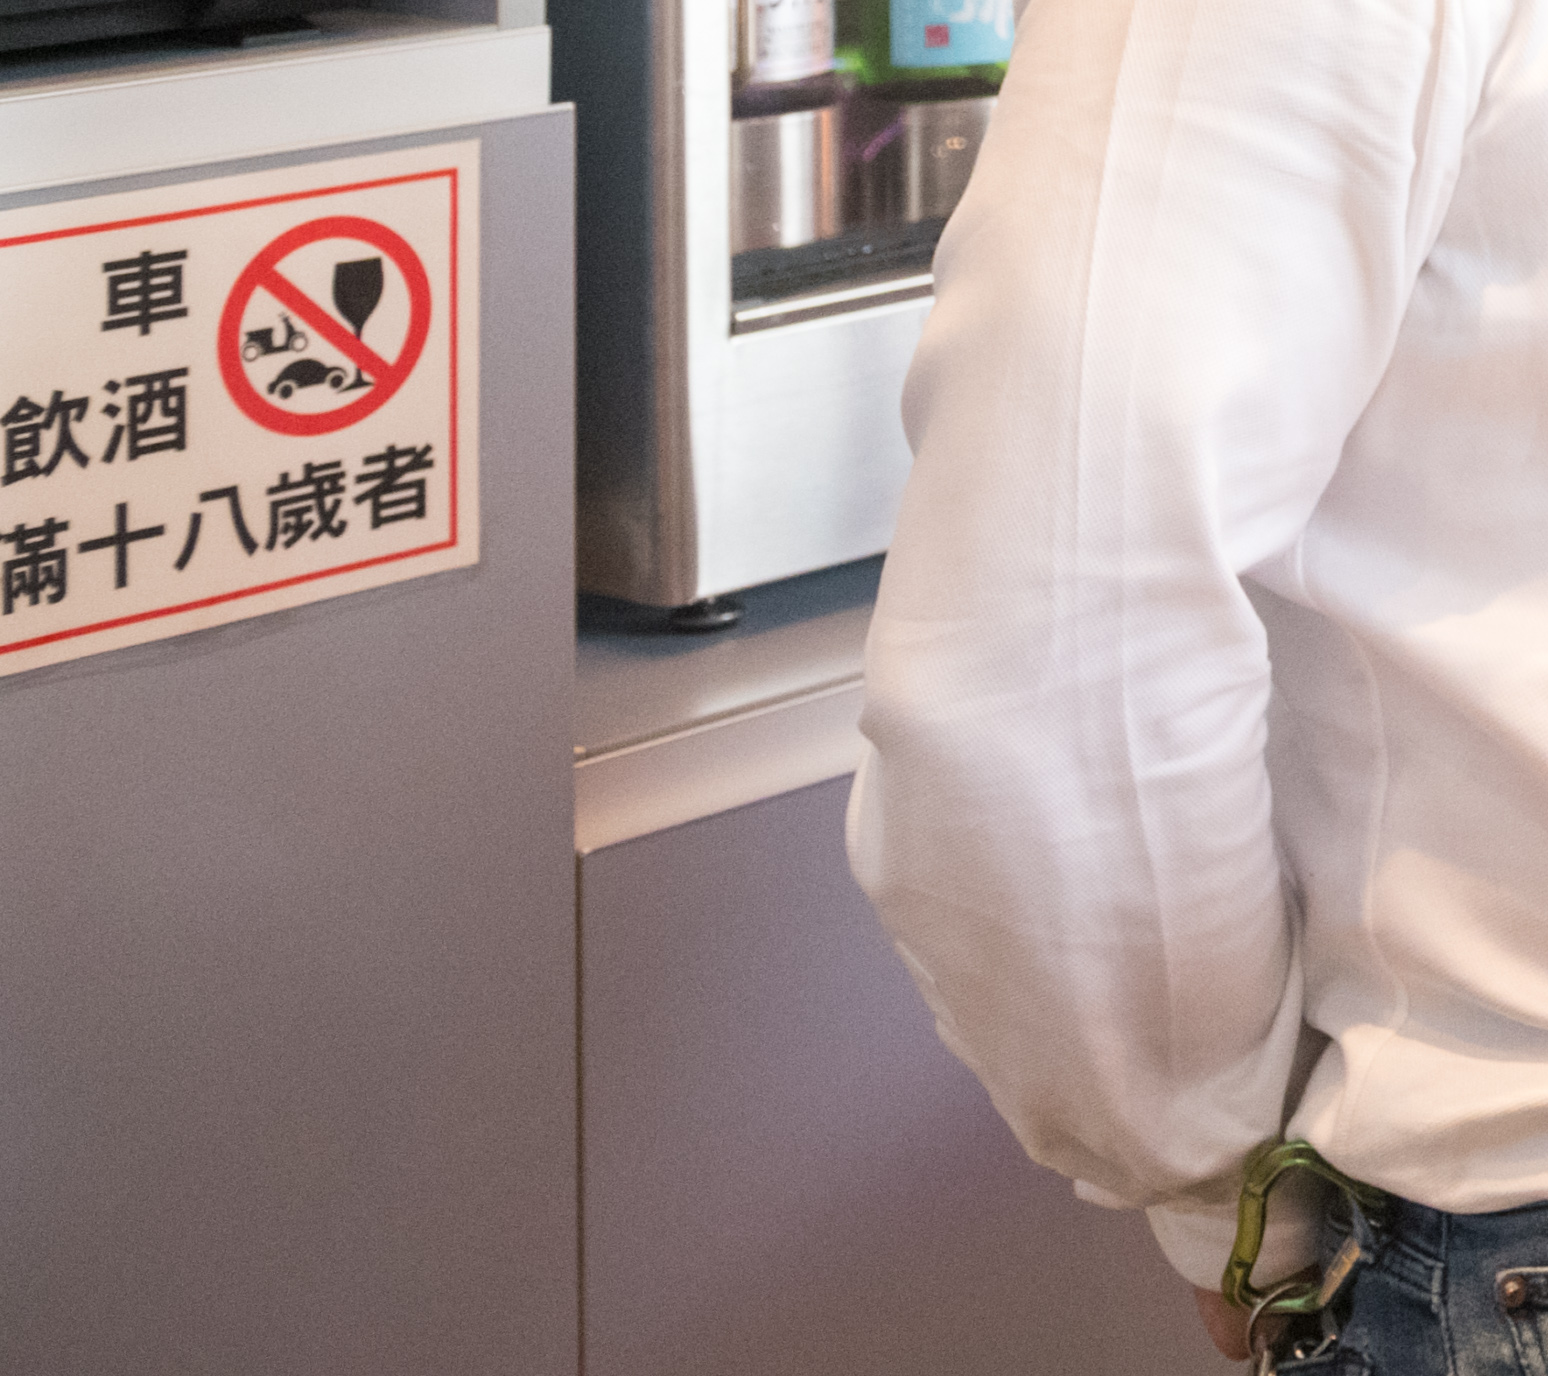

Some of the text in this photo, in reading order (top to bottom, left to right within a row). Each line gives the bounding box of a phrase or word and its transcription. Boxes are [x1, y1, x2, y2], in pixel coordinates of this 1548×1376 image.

[99, 249, 189, 336] 車
[0, 366, 189, 487] 飲酒
[0, 443, 435, 616] 滿十八歲者
